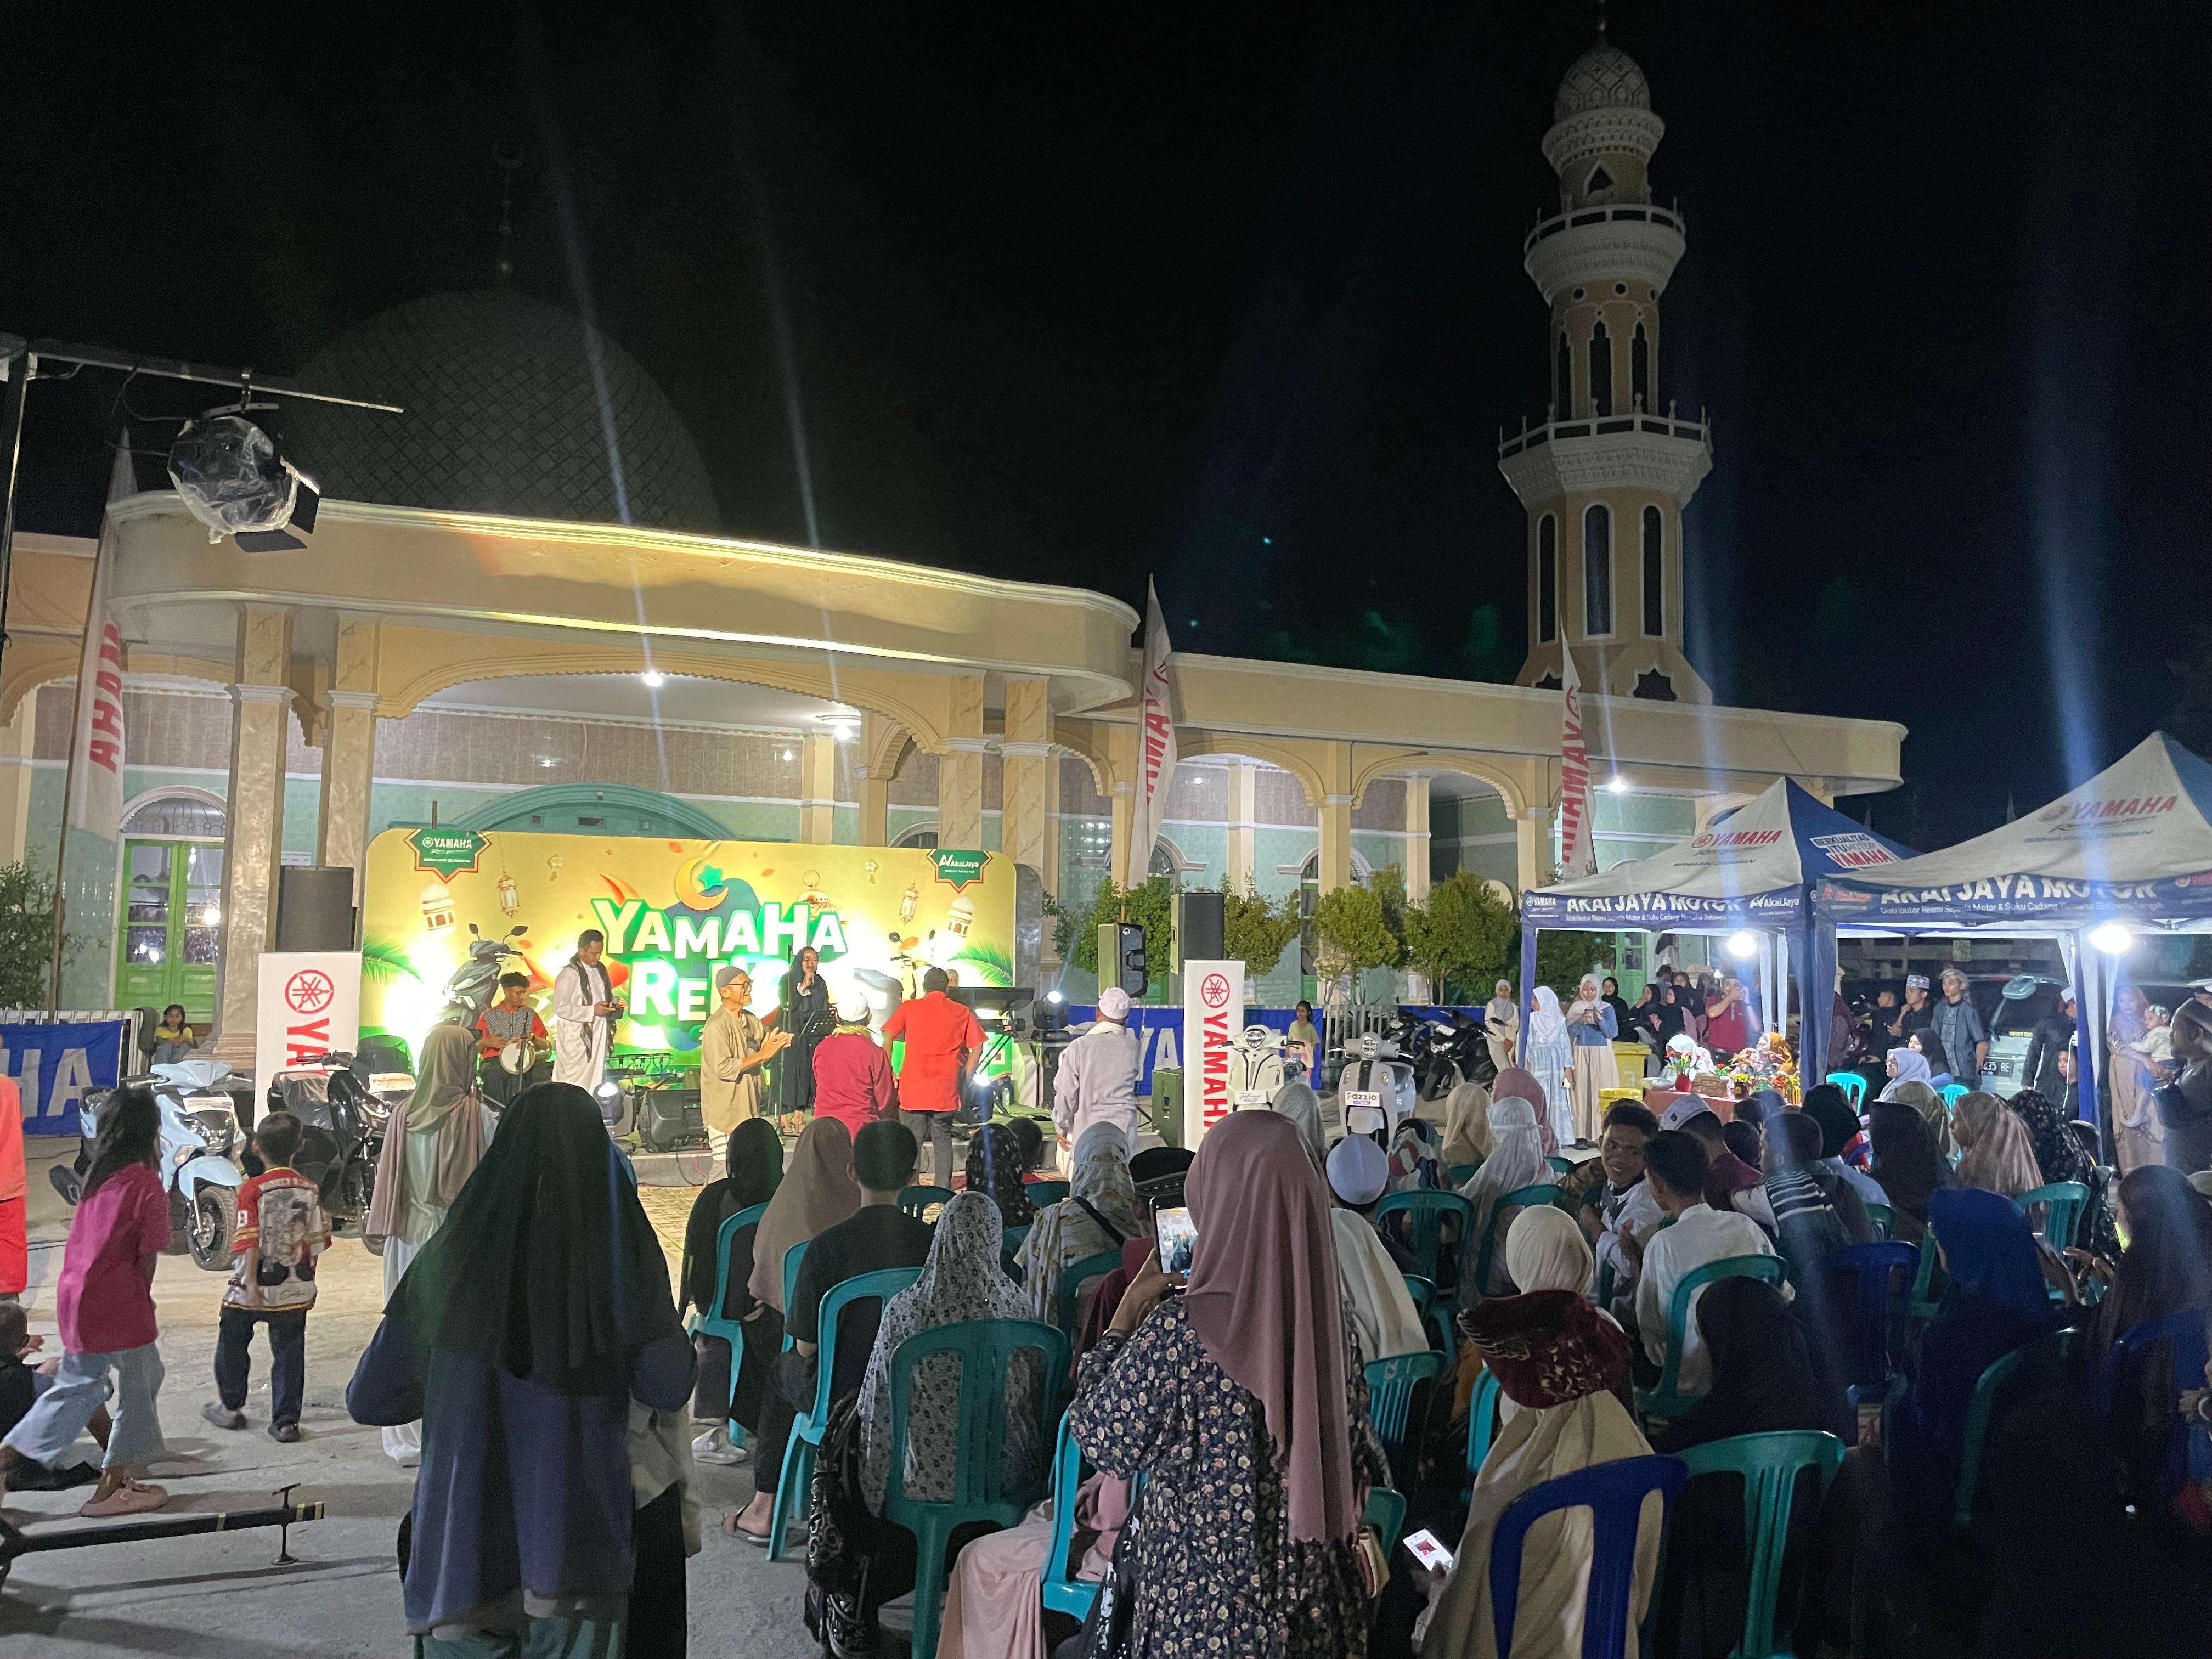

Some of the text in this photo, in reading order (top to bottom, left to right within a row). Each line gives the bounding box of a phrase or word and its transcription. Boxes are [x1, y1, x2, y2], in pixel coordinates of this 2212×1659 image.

[2072, 795, 2178, 819] YAMAHA
[435, 838, 472, 849] YAMAHA
[1711, 830, 1783, 846] YAMAHA
[1814, 834, 1870, 846] BERKUALITAS
[1830, 849, 1894, 866] YAMAHA
[1956, 874, 2036, 901] JAYA
[1534, 897, 1557, 906] YAMAHA
[1567, 898, 1611, 912] AKAI
[1615, 894, 1666, 912] JAYA
[591, 900, 847, 960] YAMAHA
[1203, 1011, 1228, 1127] YAMAH
[1347, 1092, 1376, 1101] Fazzio
